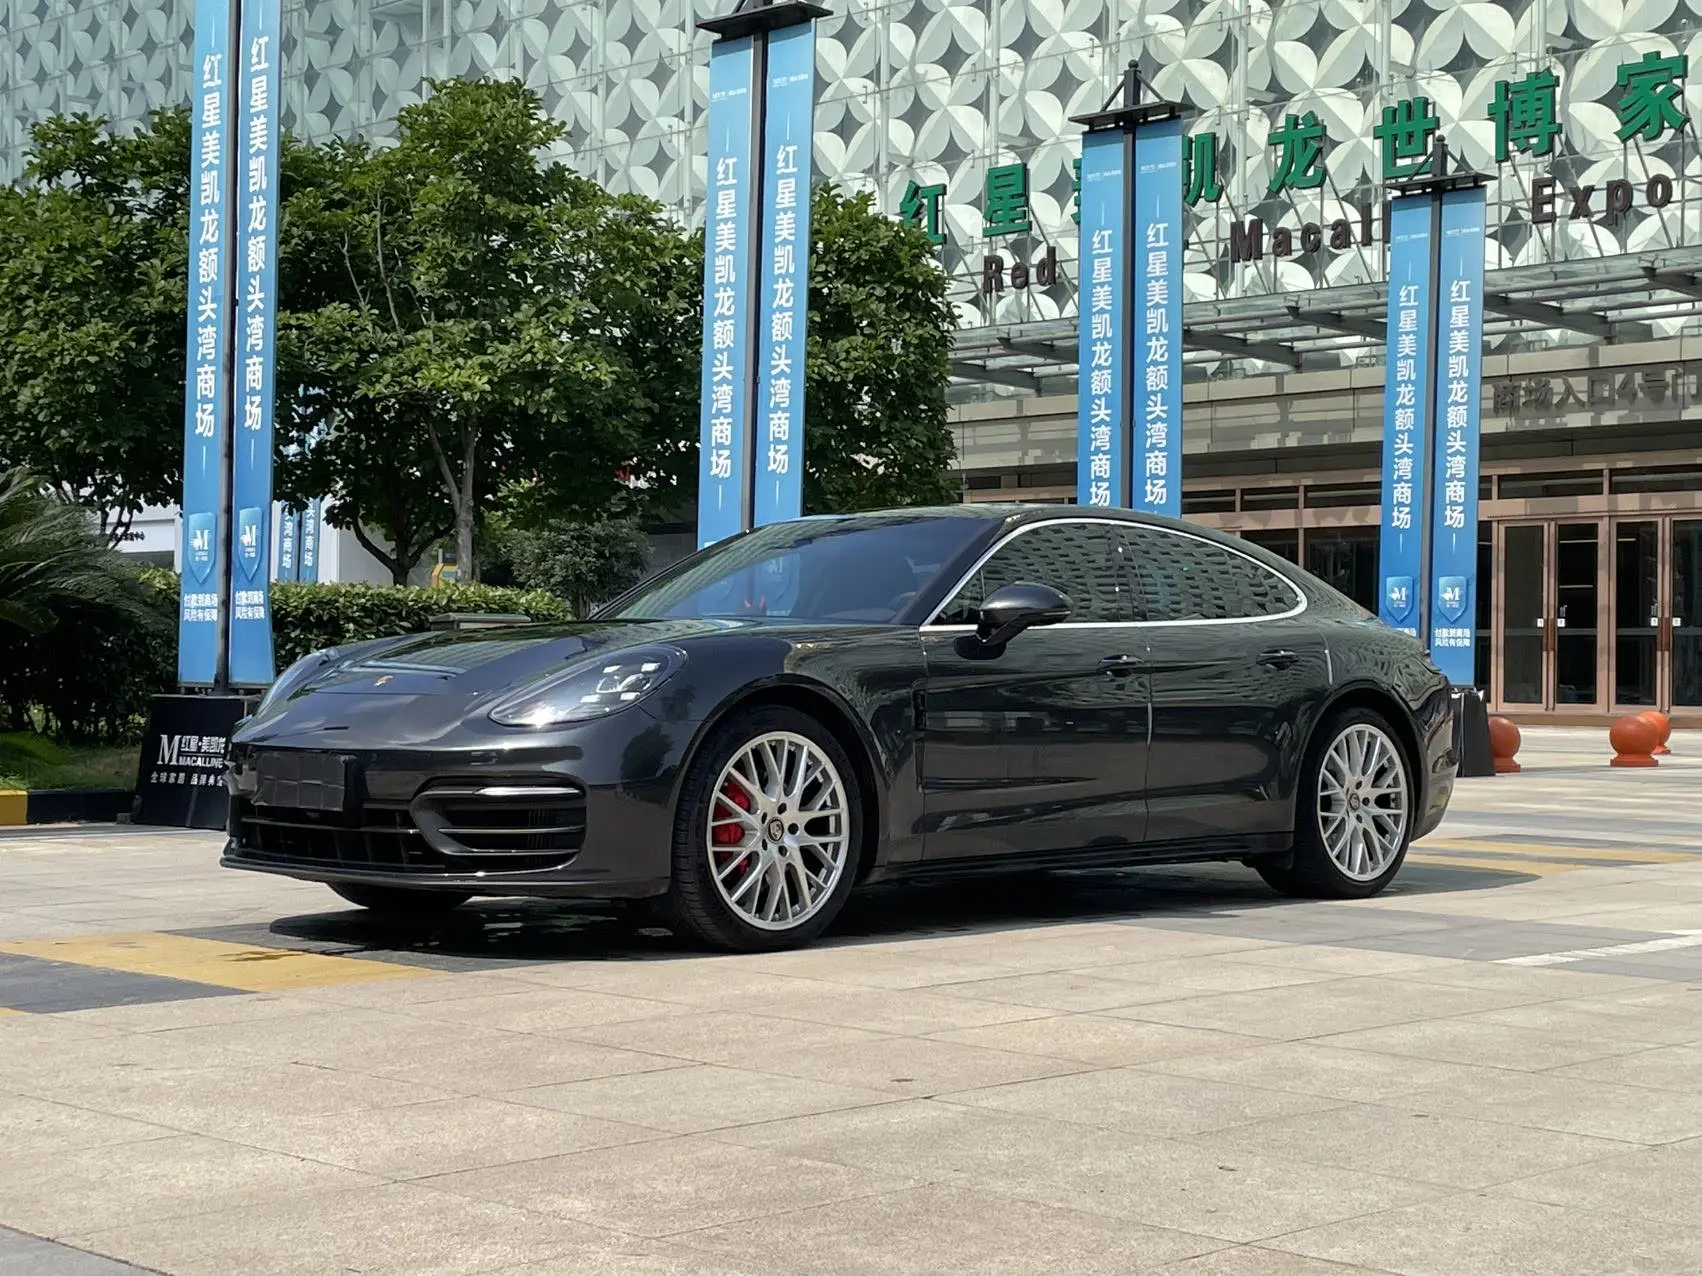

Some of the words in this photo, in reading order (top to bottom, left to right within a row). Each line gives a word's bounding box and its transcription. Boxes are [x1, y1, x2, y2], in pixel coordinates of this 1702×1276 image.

[195, 54, 222, 437] 红星美凯龙额头湾商场
[244, 36, 269, 430] 红星美凯龙额头湾商场
[899, 51, 1690, 246] 红星凯龙世博家
[983, 246, 1057, 294] Red
[1531, 173, 1673, 226] Expo
[709, 157, 738, 478] 红星美凯龙额头湾商场
[767, 145, 798, 474] 红星美凯龙额头湾商场
[1089, 230, 1113, 507] 红星美凯龙额头湾商场
[1144, 223, 1169, 505] 红星美凯龙额头湾商场
[1391, 286, 1418, 529] 红星美凯龙额头湾商场
[1444, 280, 1471, 528] 红星美凯龙额头湾商场
